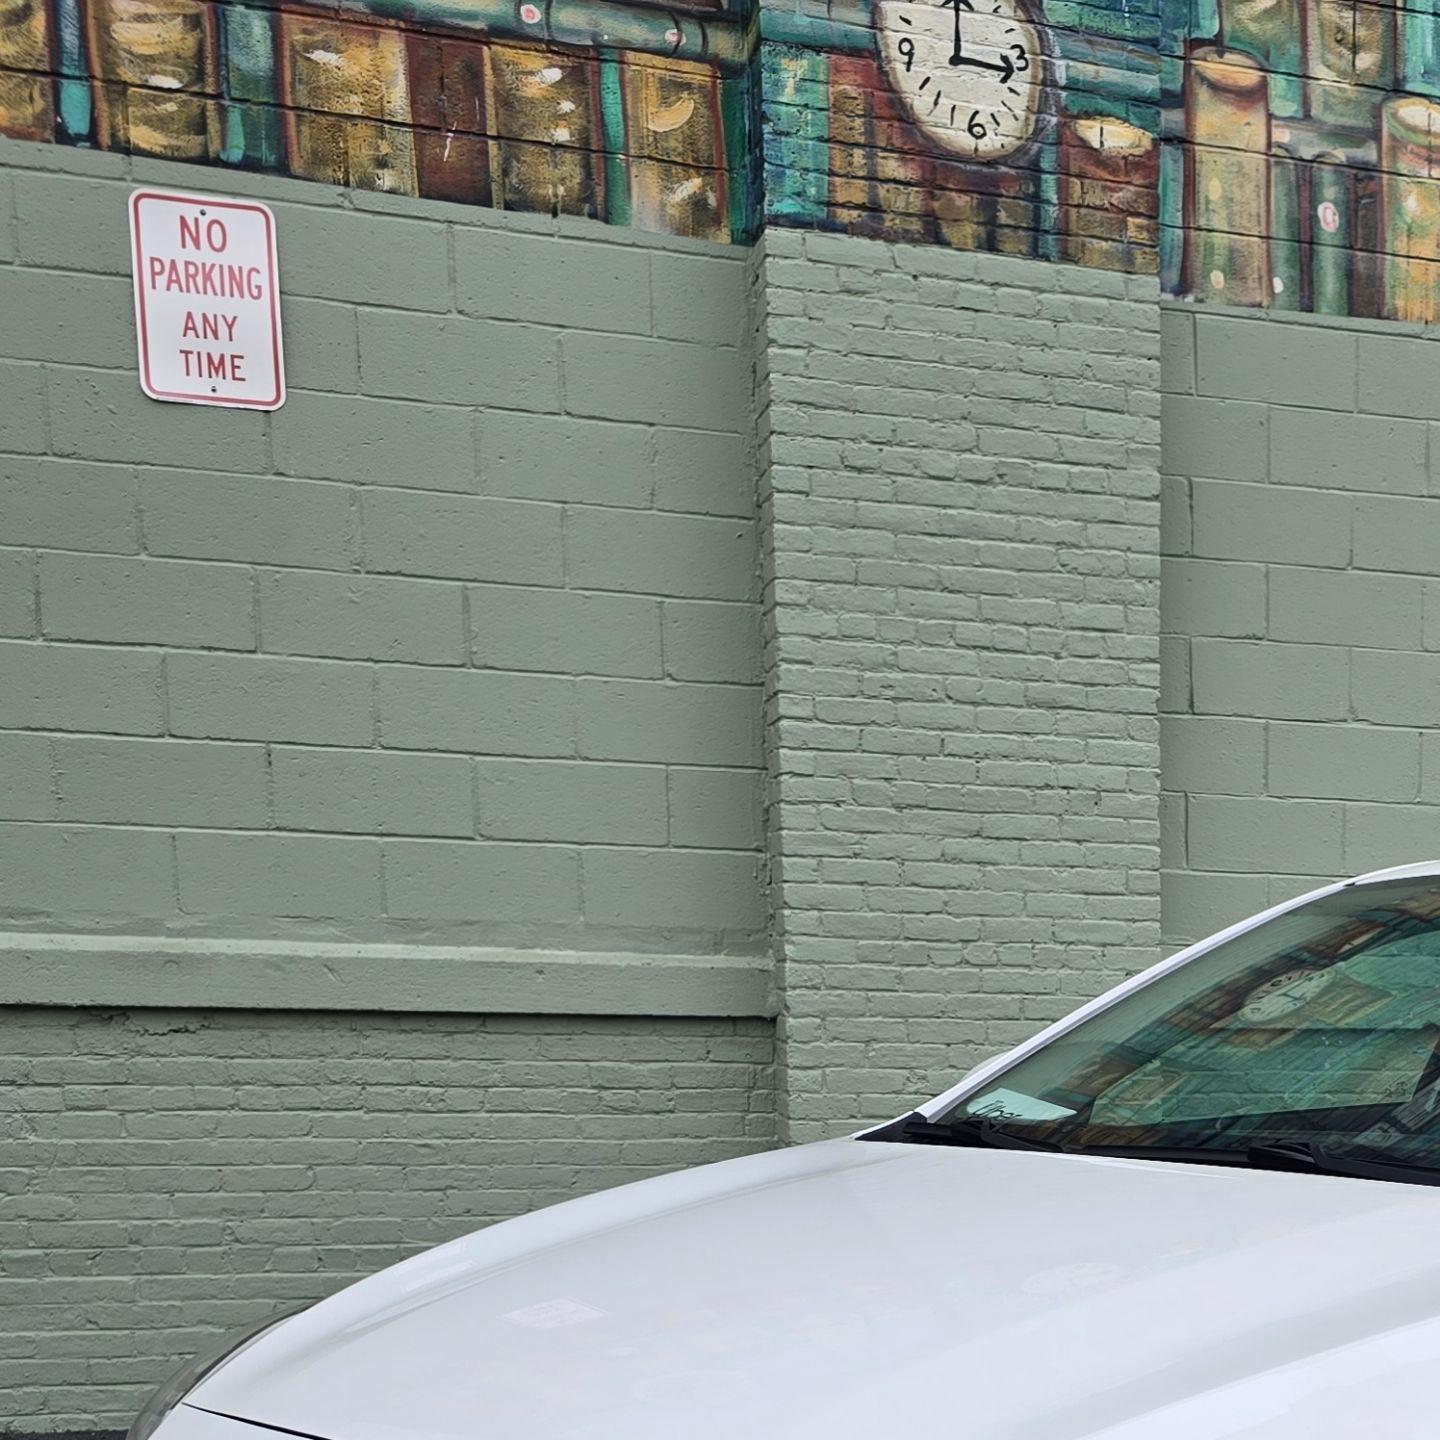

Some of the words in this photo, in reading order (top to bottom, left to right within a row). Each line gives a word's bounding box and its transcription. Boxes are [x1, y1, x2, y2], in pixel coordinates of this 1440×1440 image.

[898, 38, 914, 72] 9
[1010, 44, 1028, 71] 3
[967, 110, 987, 139] 6
[179, 215, 227, 252] NO
[150, 256, 262, 300] PARKING
[182, 311, 238, 342] ANY
[179, 349, 246, 382] TIME
